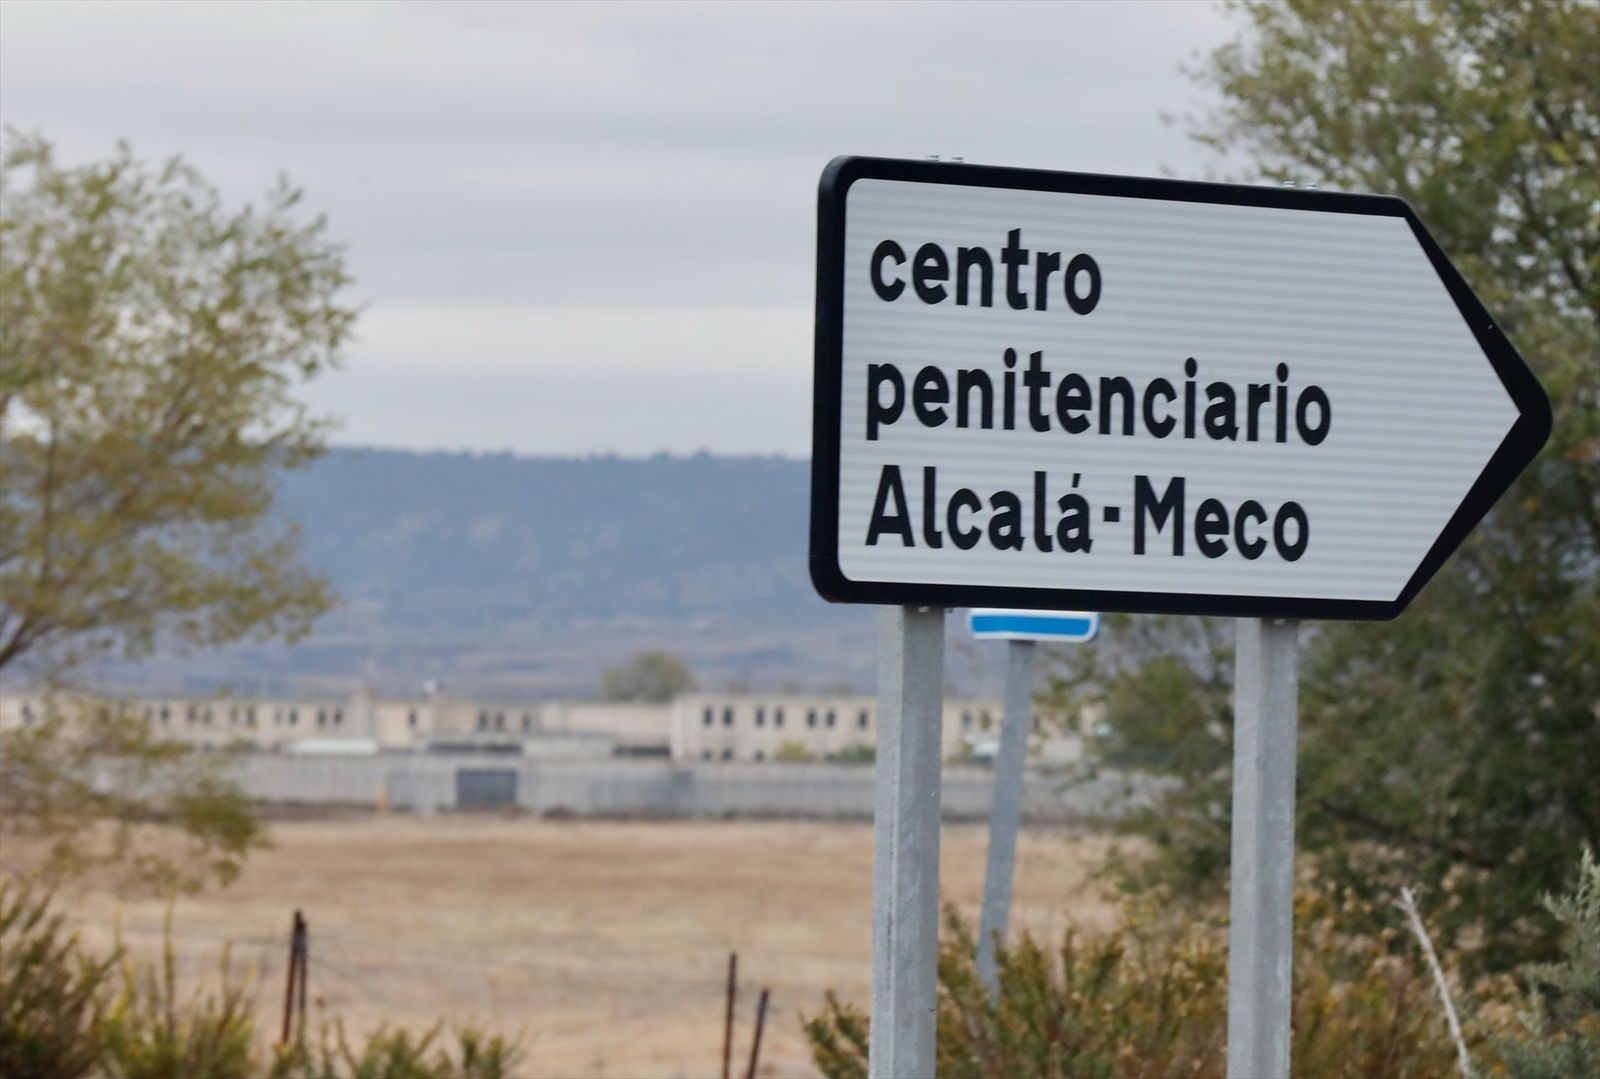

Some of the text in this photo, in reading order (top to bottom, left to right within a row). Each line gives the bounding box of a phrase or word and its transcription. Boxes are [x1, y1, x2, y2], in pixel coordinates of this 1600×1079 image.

[869, 227, 1103, 316] centro
[865, 347, 1332, 447] penitenciario
[864, 464, 1310, 563] Alcalá-Meco
